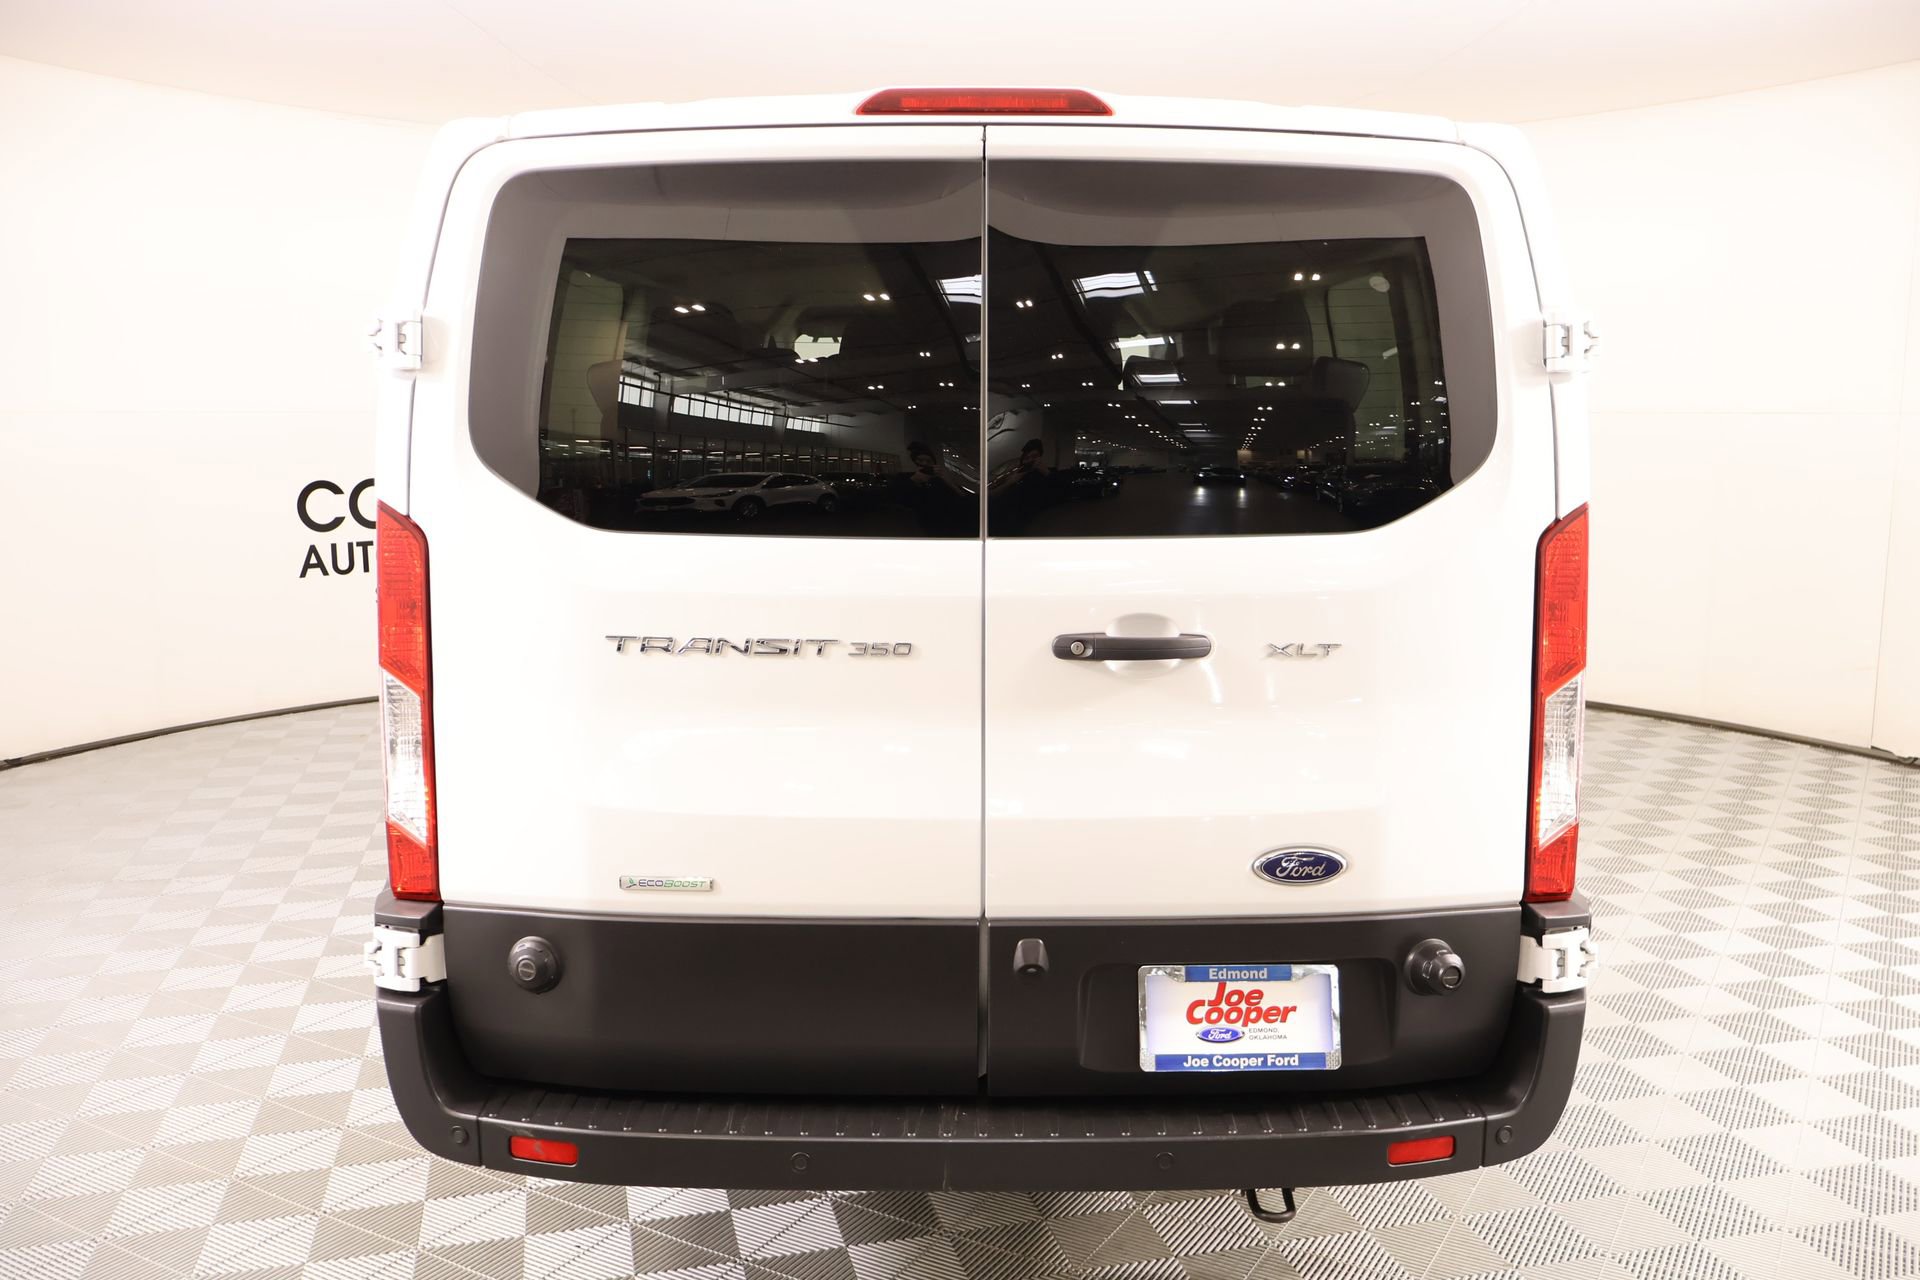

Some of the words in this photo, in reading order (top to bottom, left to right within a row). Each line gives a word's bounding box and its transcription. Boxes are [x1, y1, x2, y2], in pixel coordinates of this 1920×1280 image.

[299, 541, 374, 578] AUT
[605, 636, 839, 656] TRANSIT
[848, 642, 913, 656] 350
[1266, 643, 1342, 657] XLT
[1276, 856, 1326, 877] Ford
[1209, 968, 1268, 980] Edmond
[1208, 981, 1264, 1007] Joe
[1186, 1000, 1297, 1028] Cooper
[1207, 1028, 1232, 1040] Ford
[1183, 1056, 1209, 1067] Joe
[1213, 1055, 1263, 1069] Cooper
[1267, 1054, 1299, 1066] Ford
